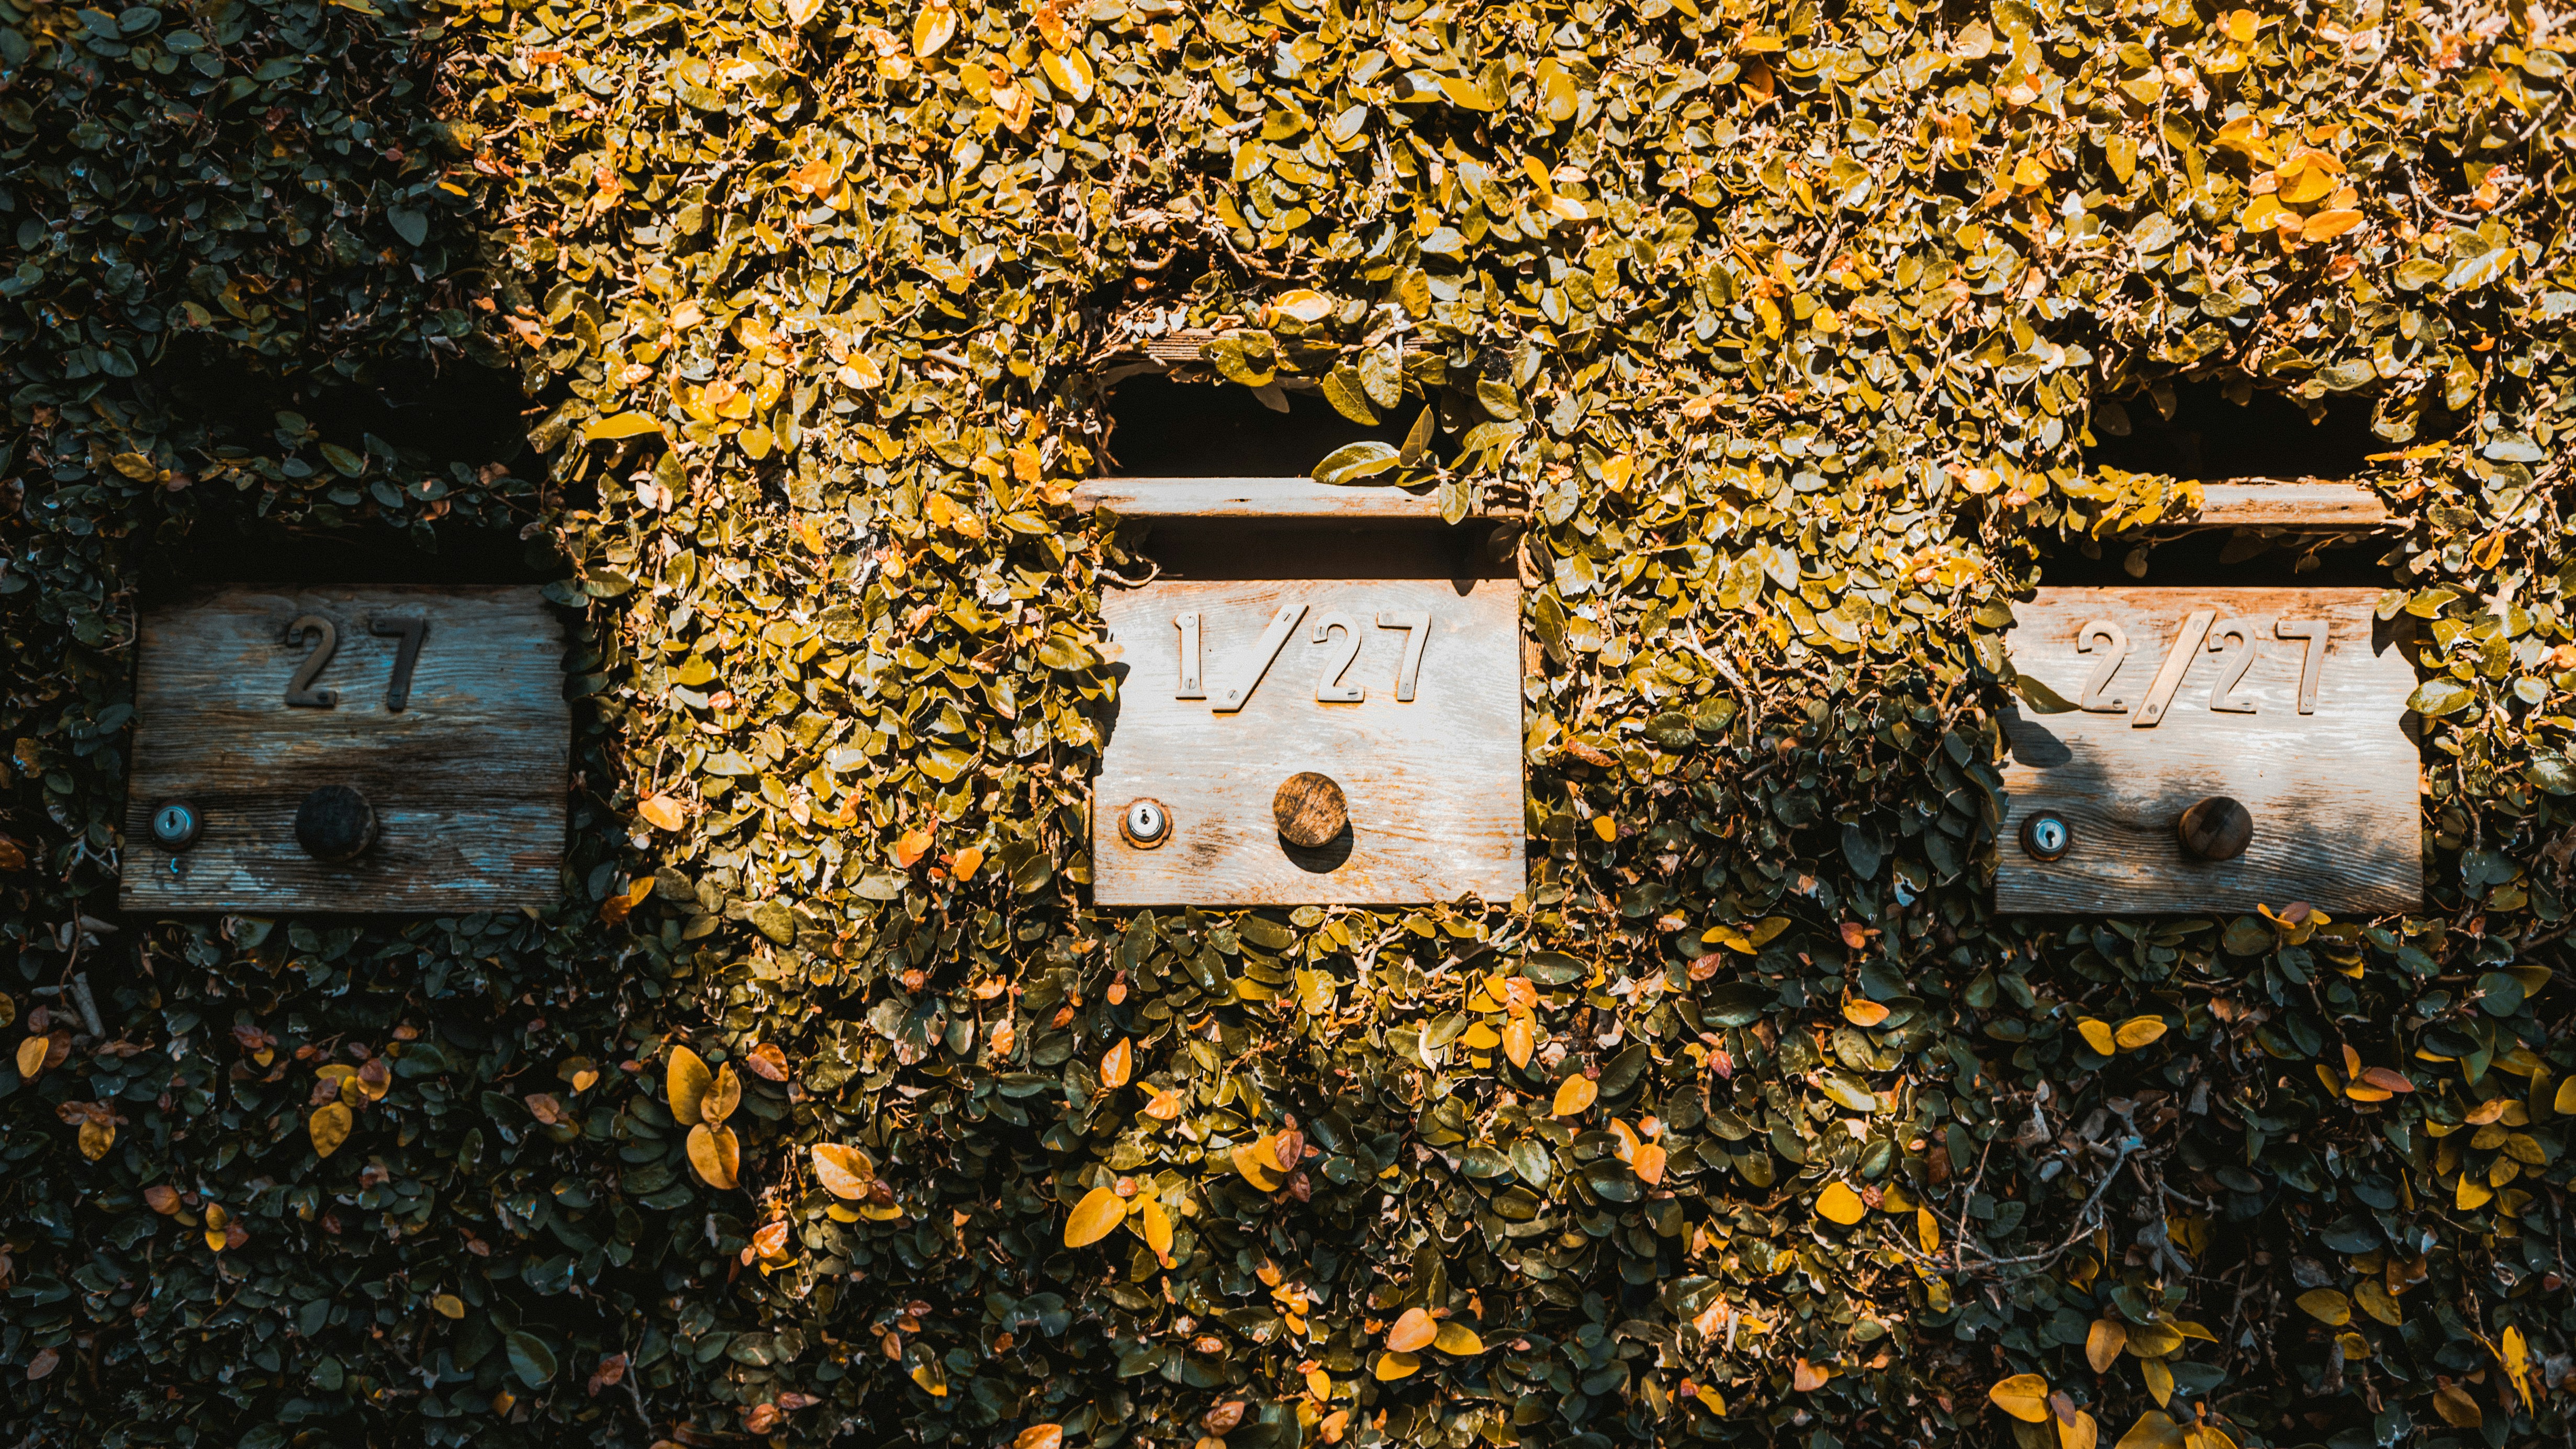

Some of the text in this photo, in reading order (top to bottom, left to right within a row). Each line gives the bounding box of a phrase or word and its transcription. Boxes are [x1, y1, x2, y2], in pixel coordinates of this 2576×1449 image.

[285, 614, 429, 711] 27
[1174, 604, 1430, 713] 1/27
[2078, 610, 2329, 727] 2/27
